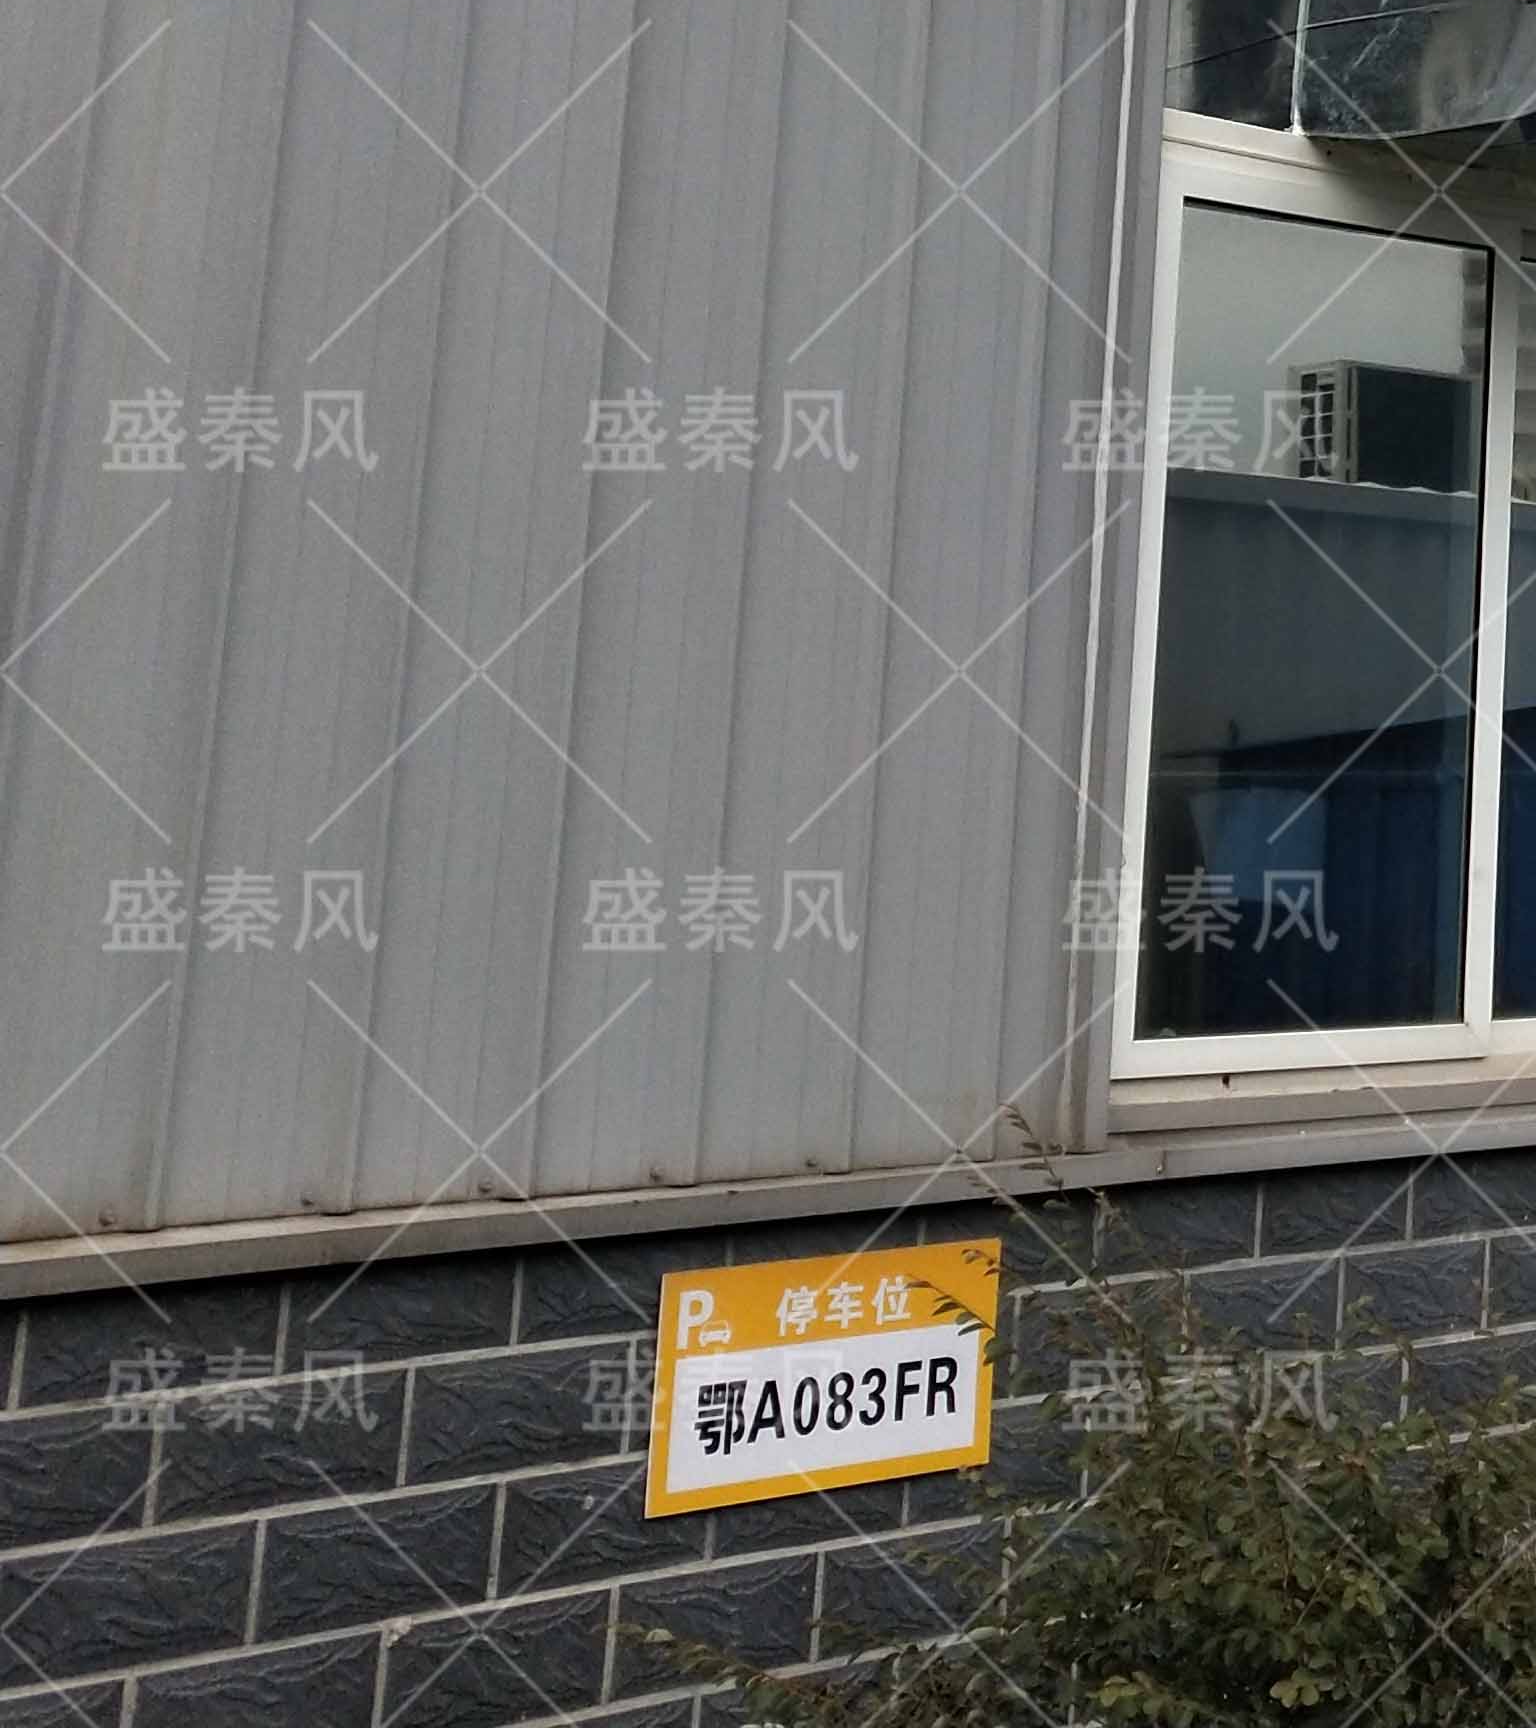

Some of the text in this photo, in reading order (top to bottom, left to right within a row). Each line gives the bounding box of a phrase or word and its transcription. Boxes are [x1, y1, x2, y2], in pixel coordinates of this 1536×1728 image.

[676, 1275, 913, 1351] P 停车位
[693, 1356, 960, 1457] 鄂A083FR
